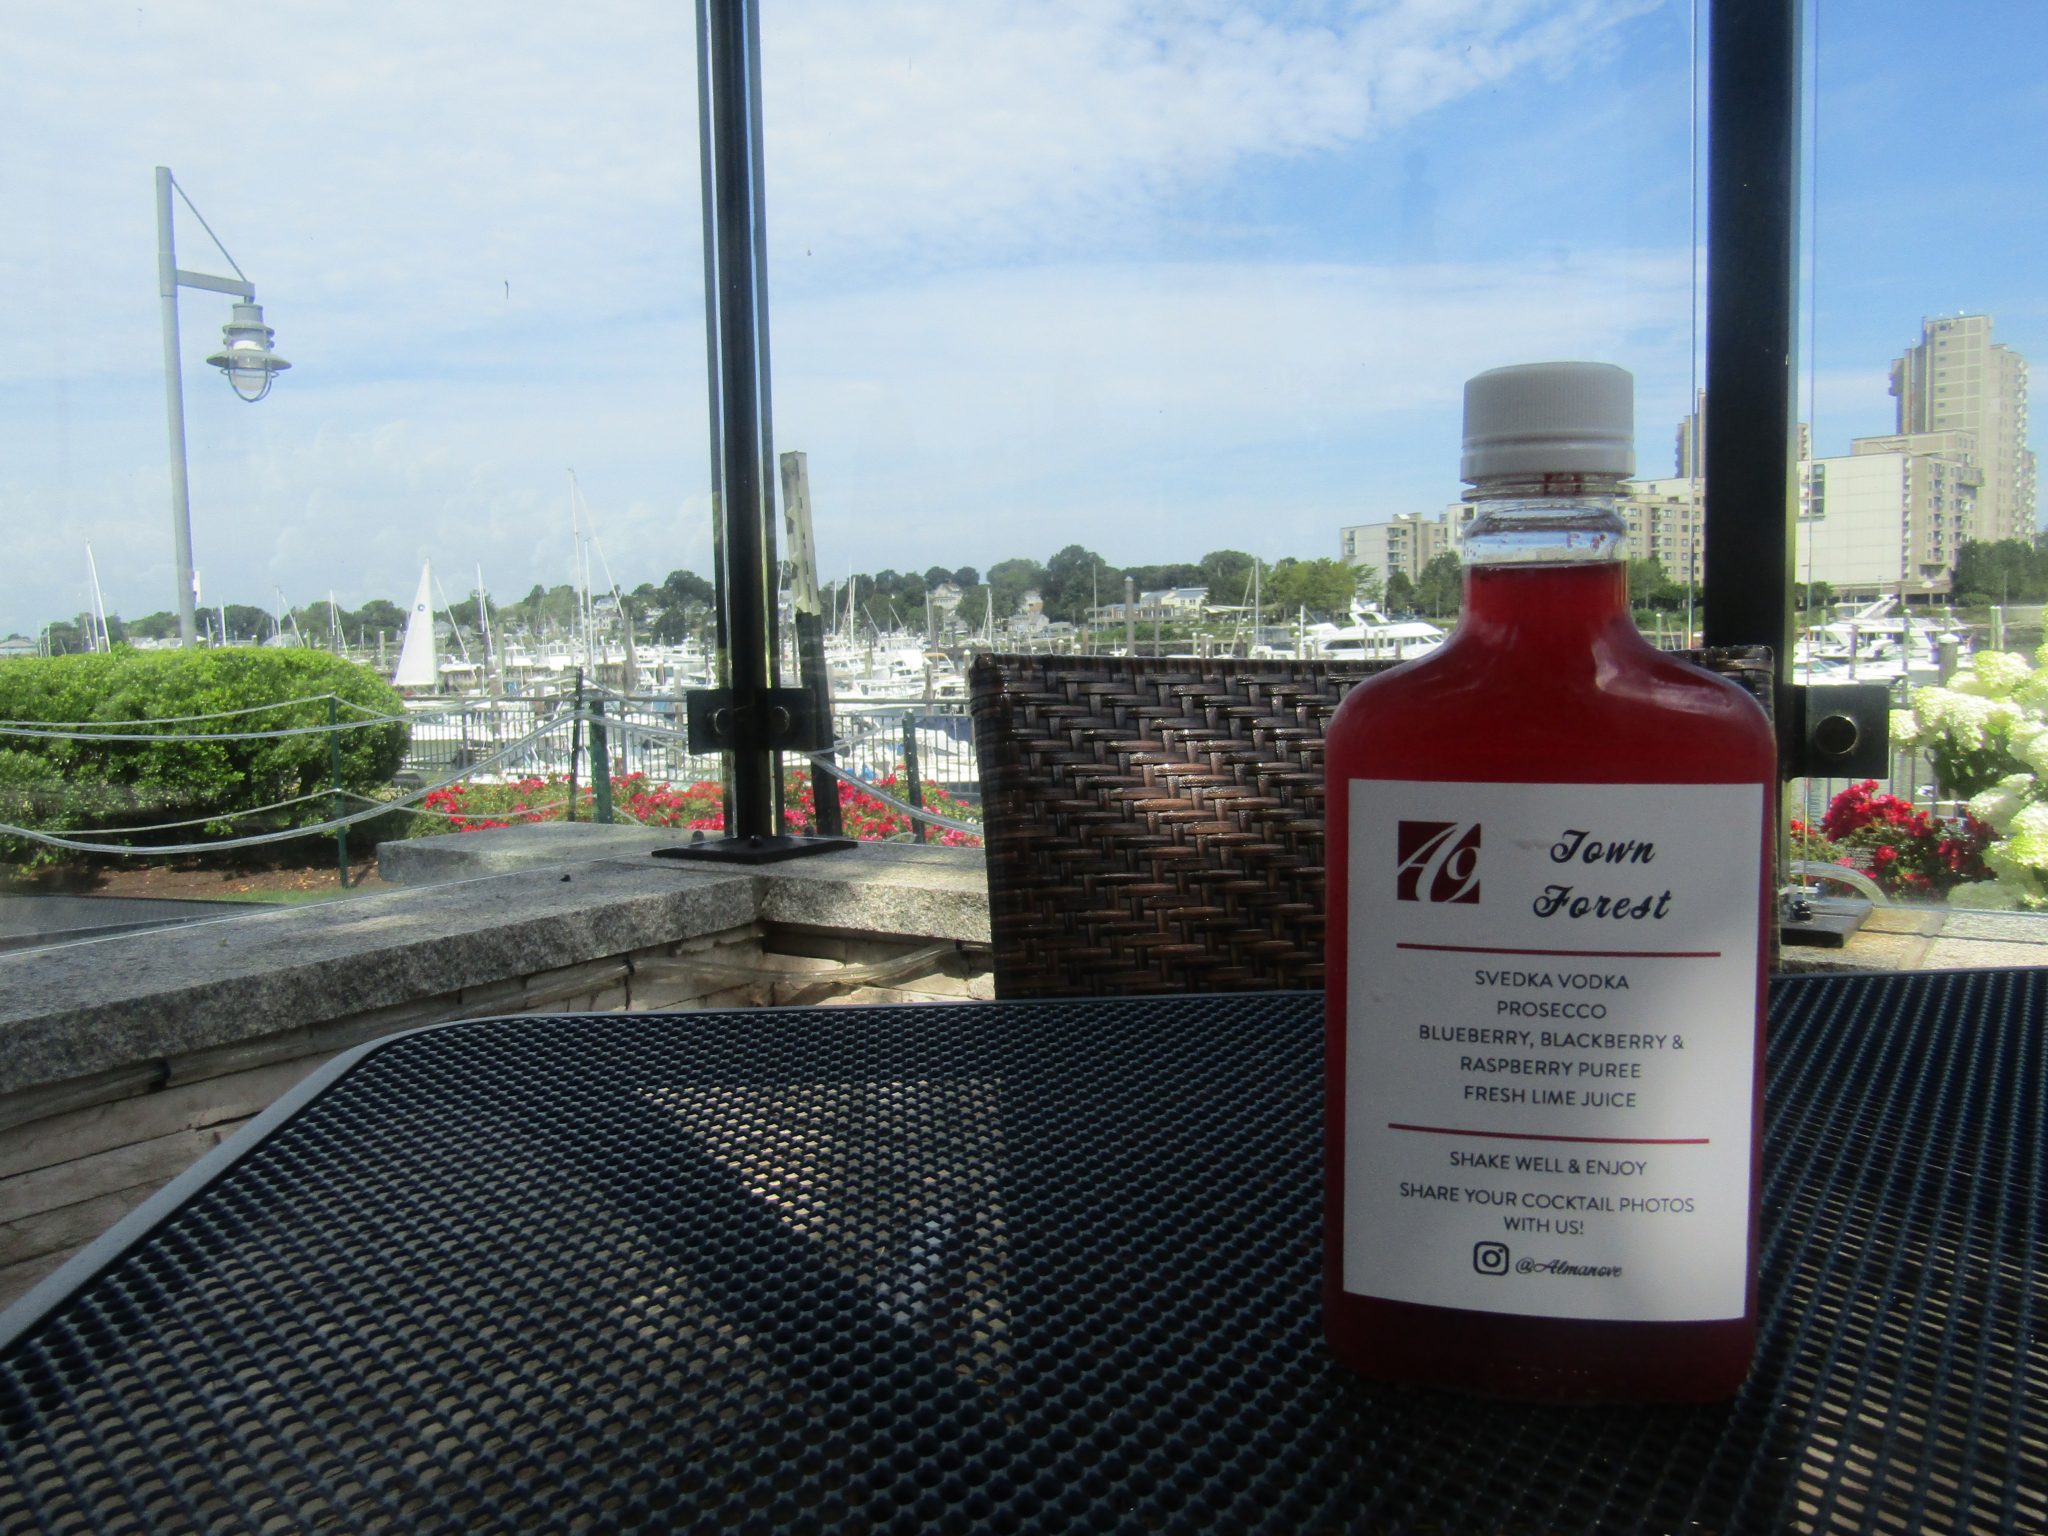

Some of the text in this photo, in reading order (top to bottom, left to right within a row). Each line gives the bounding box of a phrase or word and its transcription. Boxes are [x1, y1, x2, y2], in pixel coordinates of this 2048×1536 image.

[1550, 829, 1656, 864] Town
[1532, 884, 1672, 920] Forest
[1475, 969, 1630, 990] SVEDKA VODKA
[1497, 1000, 1608, 1020] PROSECCO
[1419, 1024, 1684, 1050] BLUEBERRY, BLACKBERRY &
[1460, 1055, 1641, 1079] RASPBERRY PUREE
[1464, 1085, 1637, 1108] FRESH LIME JUICE
[1450, 1151, 1647, 1177] SHAKE WELL & ENJOY
[1399, 1182, 1695, 1214] SHARE YOUR COCKTAIL PHOTOS
[1503, 1216, 1584, 1236] WITH US!
